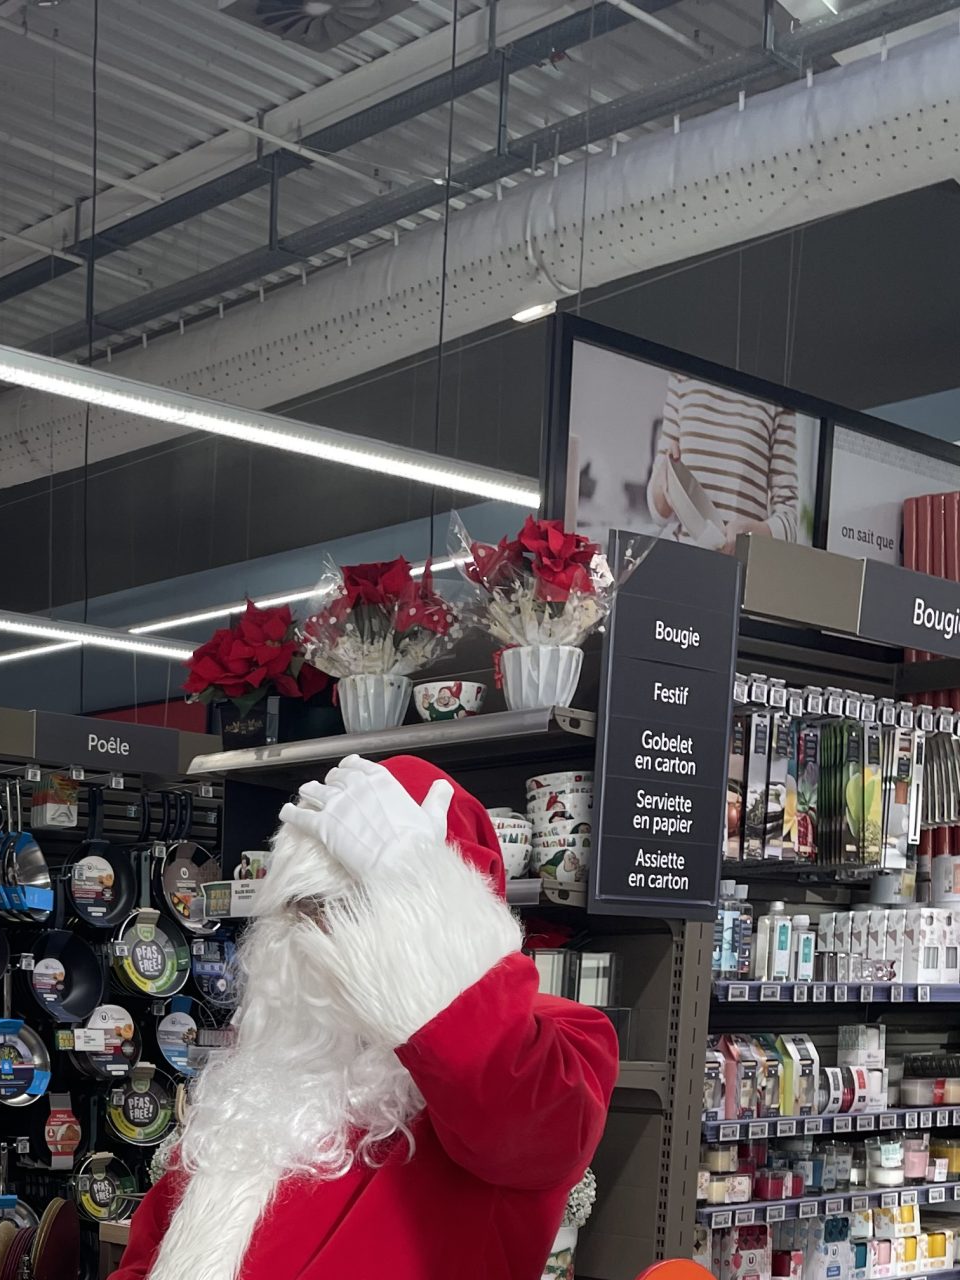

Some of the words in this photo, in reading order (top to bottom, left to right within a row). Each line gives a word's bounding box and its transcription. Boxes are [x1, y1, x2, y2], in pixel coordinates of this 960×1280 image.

[841, 526, 855, 540] on
[857, 529, 874, 545] sait
[876, 535, 894, 551] que
[913, 598, 960, 639] Bougi
[655, 620, 700, 649] Bougie
[654, 682, 689, 705] Festif
[88, 734, 130, 755] Poêle
[641, 730, 693, 754] Gobelet
[635, 755, 651, 770] en
[655, 757, 696, 775] carton
[636, 789, 692, 813] Serviette
[633, 815, 650, 829] en
[652, 814, 693, 836] papier
[635, 848, 685, 870] Assiette
[628, 872, 645, 887] en
[647, 873, 689, 890] carton
[135, 945, 158, 960] PFAS
[139, 955, 162, 972] FREE!
[128, 1096, 150, 1109] PFAS
[129, 1105, 153, 1120] FREE!
